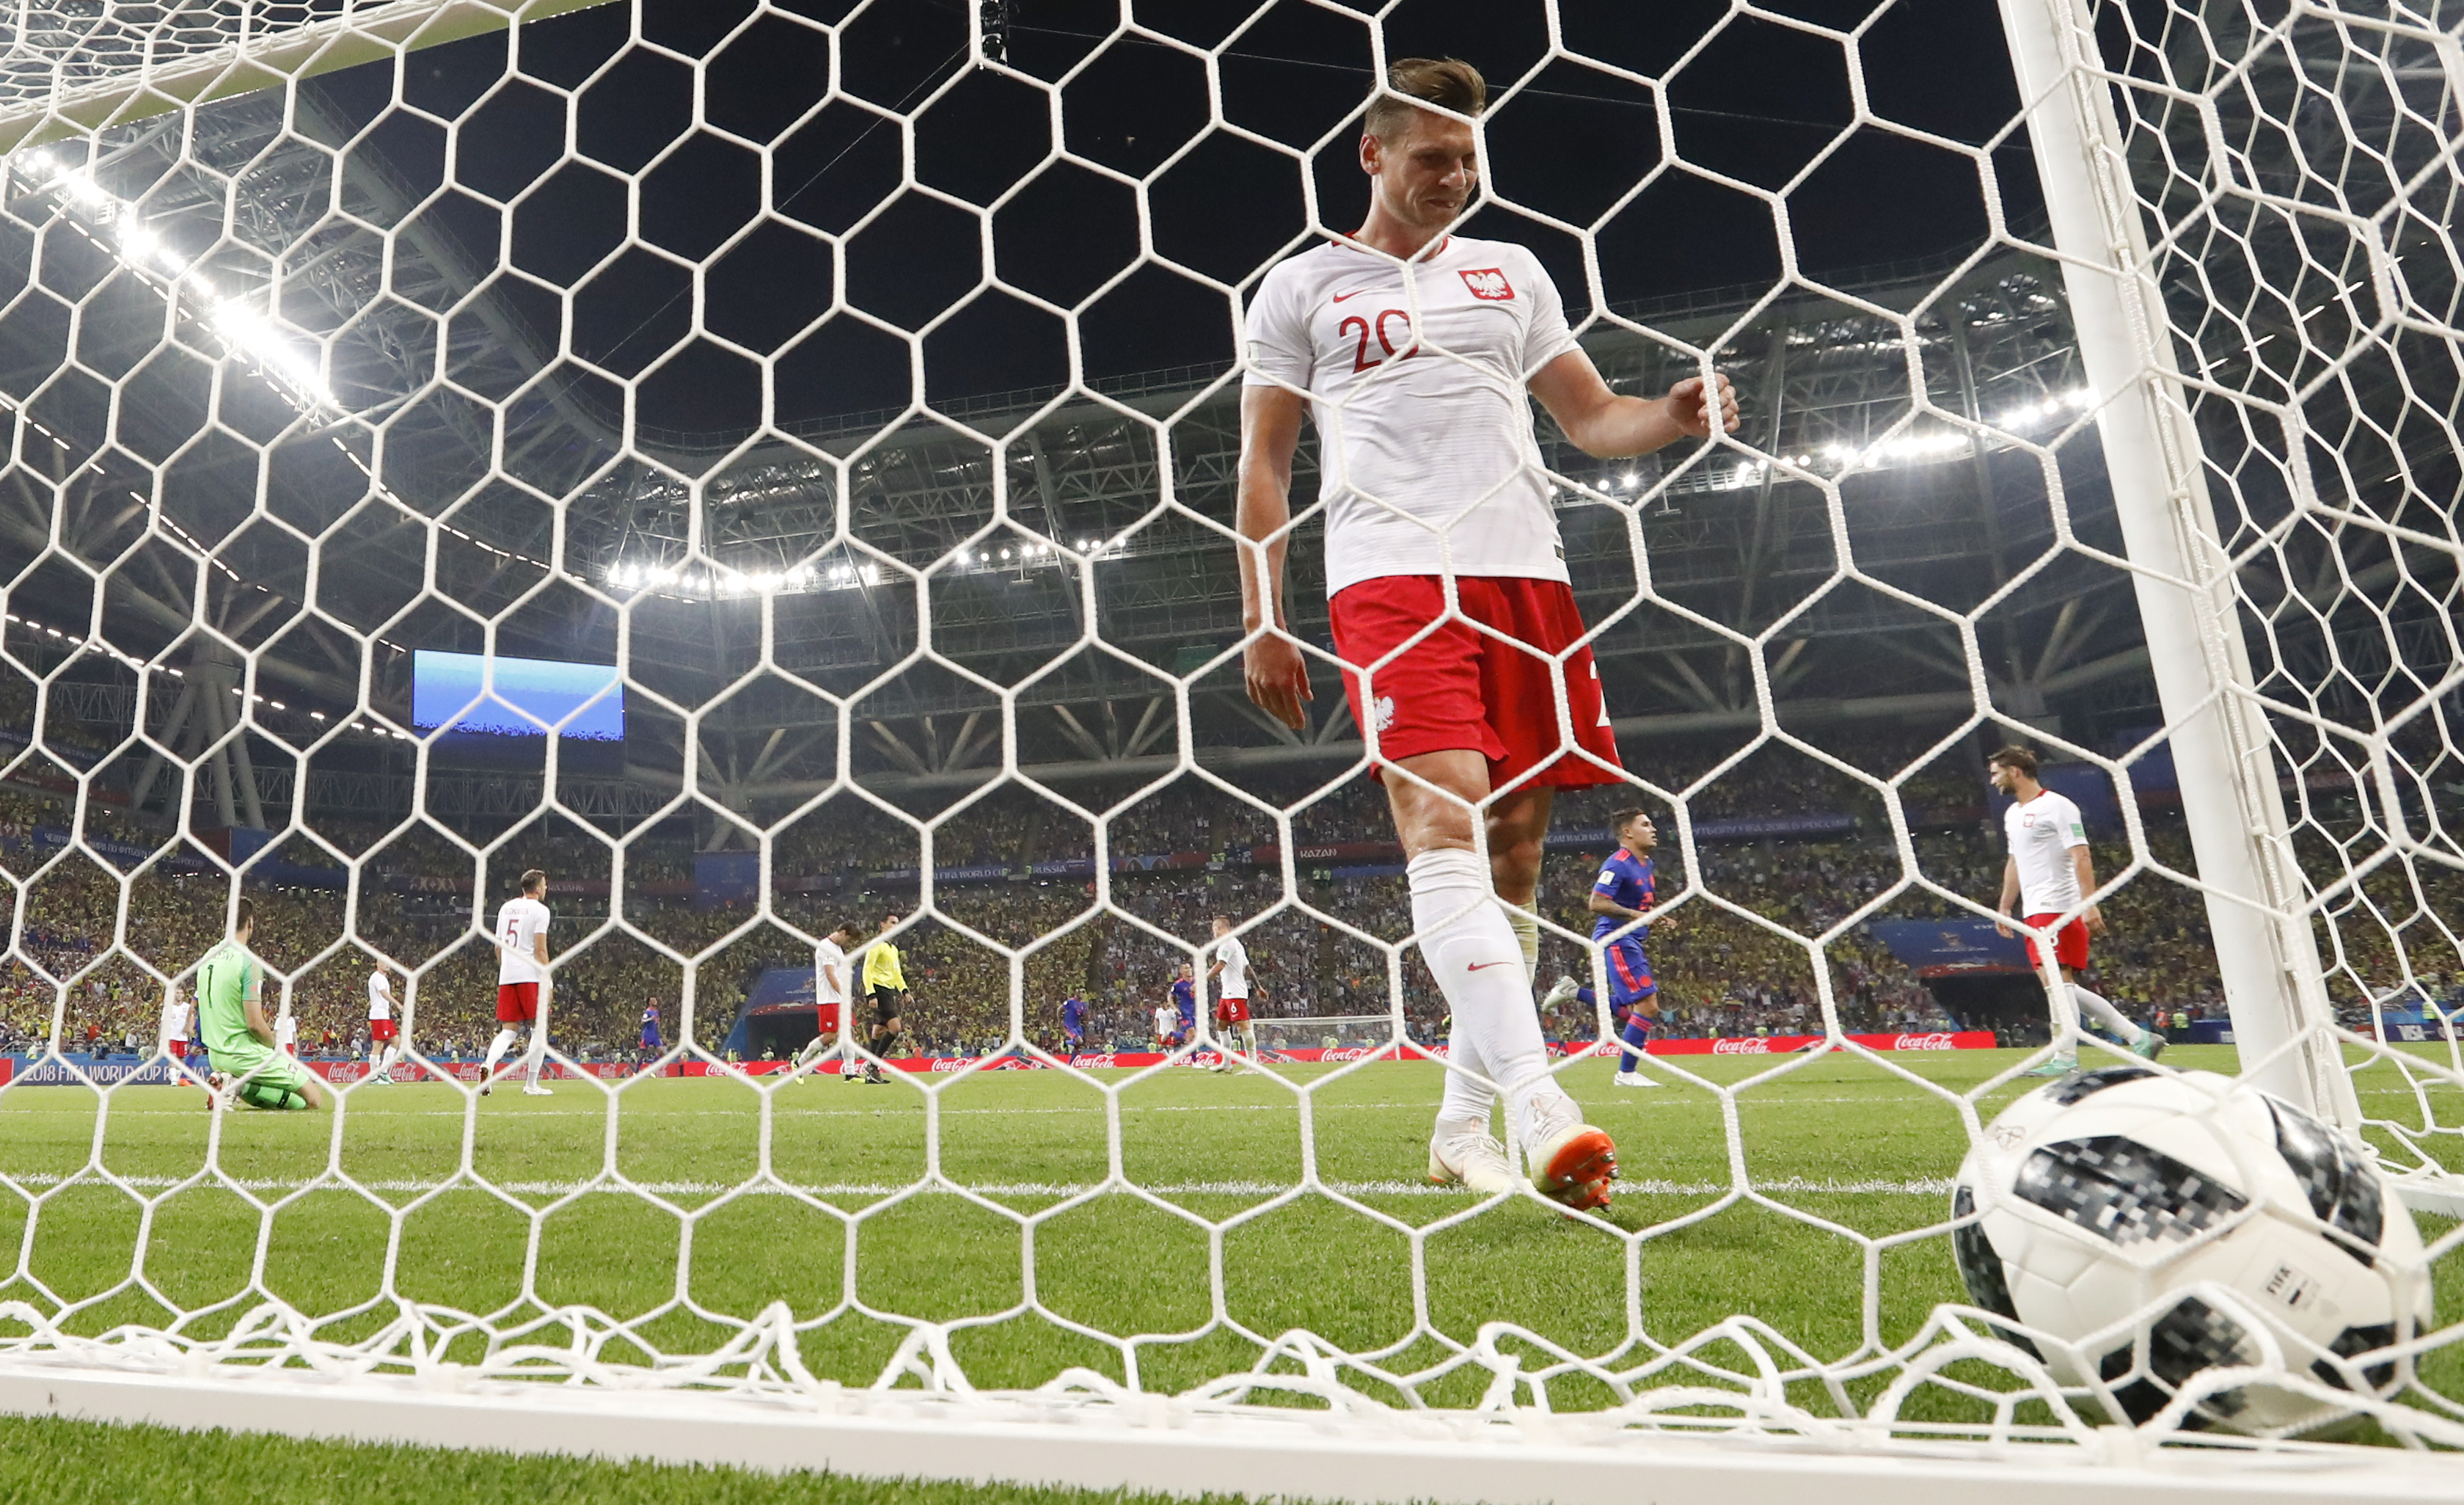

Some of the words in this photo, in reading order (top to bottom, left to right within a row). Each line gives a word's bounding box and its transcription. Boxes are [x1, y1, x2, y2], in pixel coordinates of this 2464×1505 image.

[1338, 308, 1419, 374] 20
[1300, 848, 1337, 859] KAZAN
[960, 870, 991, 878] WORLD
[1033, 865, 1067, 874] RUSSIA
[505, 919, 519, 948] 5
[208, 964, 213, 1009] 1
[1231, 1002, 1238, 1013] 6
[1713, 1038, 1769, 1054] Coca-Cola
[1894, 1032, 1956, 1050] Coca-Cola
[1070, 1054, 1116, 1069] Coca-Cola
[1321, 1048, 1370, 1063] Coca-Col
[328, 1063, 359, 1082] Coca-Cola
[932, 1058, 975, 1072] Coca-Col
[24, 1065, 56, 1082] 2018
[89, 1065, 134, 1082] WORLD
[2266, 1266, 2292, 1295] FIFA
